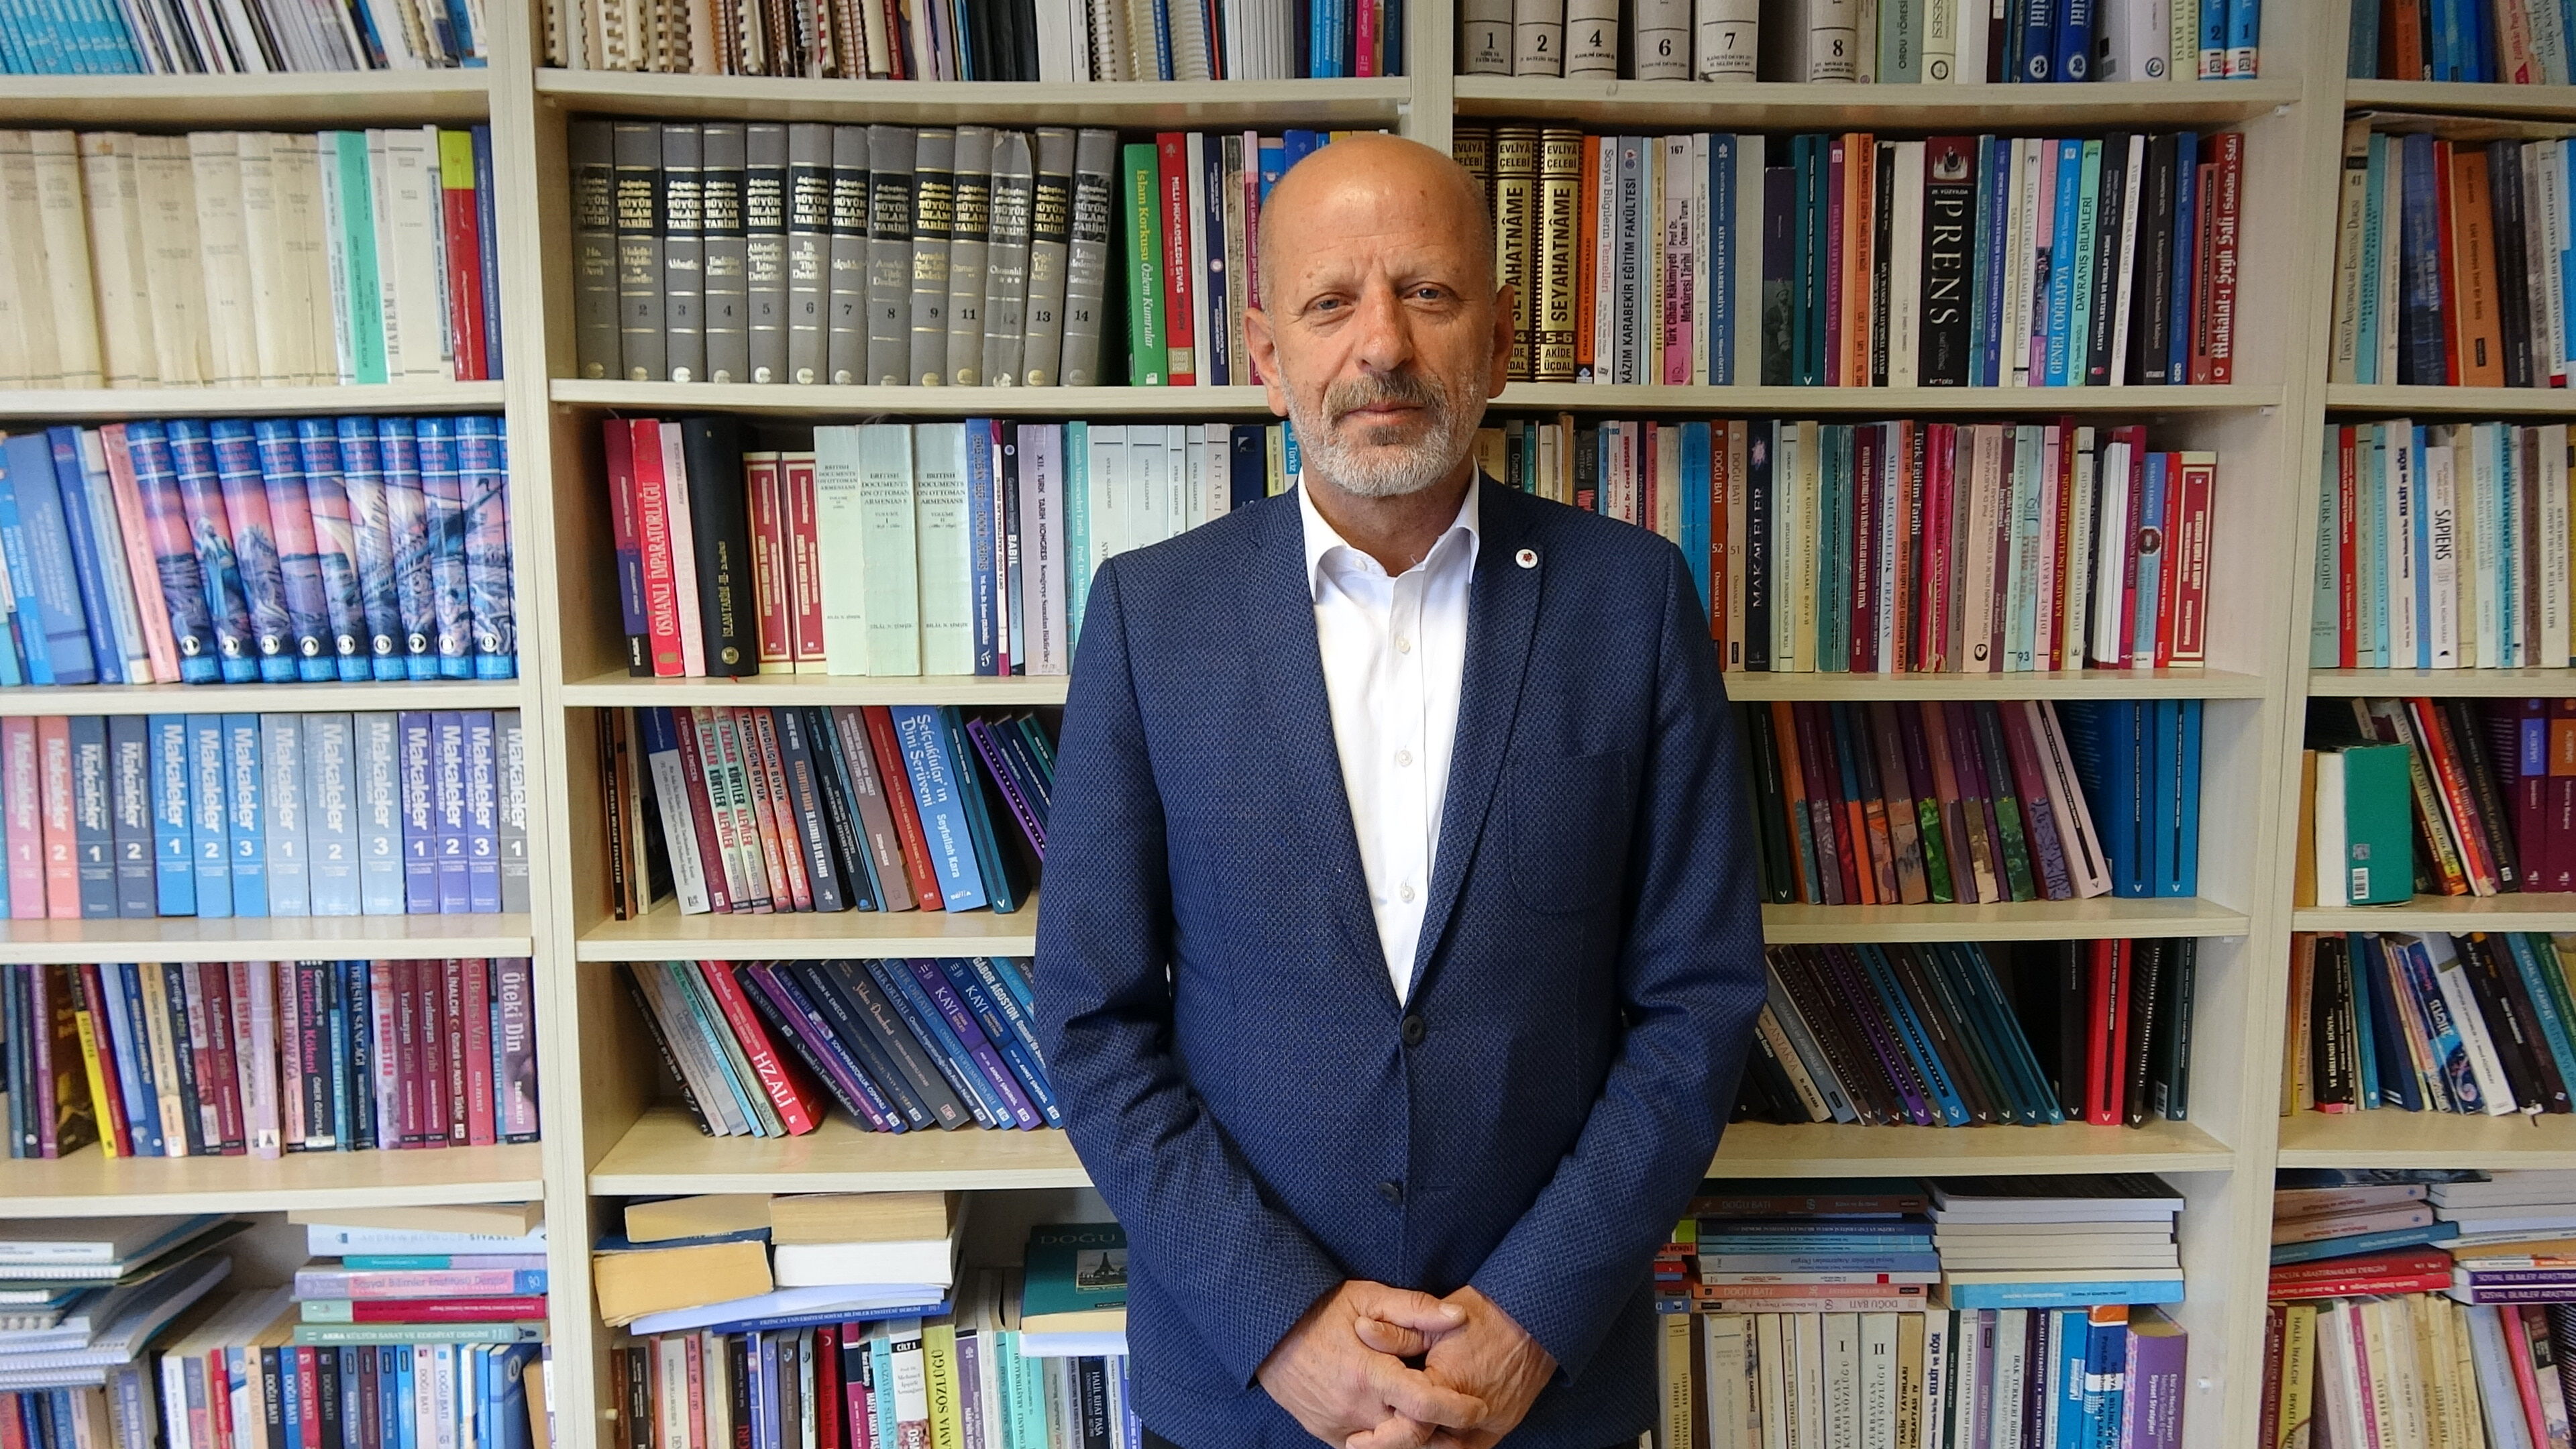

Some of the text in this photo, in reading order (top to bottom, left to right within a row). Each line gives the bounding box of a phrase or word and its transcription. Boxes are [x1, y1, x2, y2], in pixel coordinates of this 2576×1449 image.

[1590, 29, 1602, 47] 4
[2210, 26, 2220, 41] 2
[2242, 25, 2249, 38] 1
[1487, 33, 1495, 48] 1
[1537, 35, 1548, 51] 2
[1659, 39, 1671, 56] 6
[1725, 32, 1735, 50] 7
[1833, 39, 1843, 56] 8
[1671, 146, 1683, 154] 167
[1500, 158, 1530, 168] ÇELEBİ
[1547, 158, 1576, 169] ÇELEBİ
[1136, 170, 1154, 347] İslam Korkusu Özlem Kumrular
[1929, 199, 1963, 325] PRENS
[639, 305, 647, 316] 2
[678, 305, 686, 316] 3
[723, 305, 731, 317] 4
[763, 303, 770, 314] 5
[806, 303, 814, 313] 6
[843, 305, 851, 315] 7
[887, 309, 895, 319] 8
[930, 309, 938, 319] 9
[961, 309, 976, 319] 11
[1035, 311, 1051, 321] 13
[1075, 311, 1089, 321] 14
[1623, 287, 1633, 345] KARABEKİR
[2050, 266, 2069, 374] GENEL COĞRAFYA
[1546, 333, 1572, 343] 5-6
[1666, 327, 1676, 346] Türk
[1714, 450, 1723, 504] DOĞU BATI
[1911, 431, 1923, 535] Türk Eğitim Tarihi
[2435, 509, 2451, 560] SAPIENS
[1713, 543, 1723, 553] 52
[1730, 546, 1740, 554] 51
[1752, 488, 1764, 608] MAKALELER
[639, 482, 674, 637] OSMANLI İMPARATORLUĞU
[2018, 651, 2029, 661] 93
[902, 716, 932, 808] Dini Serüveni
[14, 733, 32, 831] Makaleler
[162, 724, 184, 829] Makaleler
[200, 729, 219, 833] Makaleler
[235, 727, 256, 831] Makaleler
[276, 727, 295, 831] Makaleler
[322, 727, 348, 833] Makaleler
[370, 722, 389, 829] Makaleler
[408, 727, 427, 831] Makaleler
[443, 724, 463, 830] Makaleler
[471, 726, 490, 831] Makaleler
[506, 728, 526, 831] Makaleler
[48, 738, 67, 831] Makaleler
[80, 743, 99, 831] Makaleler
[121, 741, 138, 829] Makaleler
[20, 845, 30, 860] 1
[52, 845, 66, 860] 2
[90, 845, 101, 862] 1
[127, 843, 142, 859] 2
[168, 839, 181, 855] 1
[205, 843, 219, 859] 2
[239, 841, 254, 857] 3
[282, 841, 294, 857] 1
[329, 844, 342, 859] 2
[374, 838, 389, 855] 3
[413, 841, 425, 856] 1
[445, 839, 460, 855] 2
[475, 839, 490, 855] 3
[511, 840, 523, 856] 1
[935, 987, 958, 1016] KAYI
[966, 985, 988, 1014] KAYI
[502, 973, 525, 1052] Öteki Din
